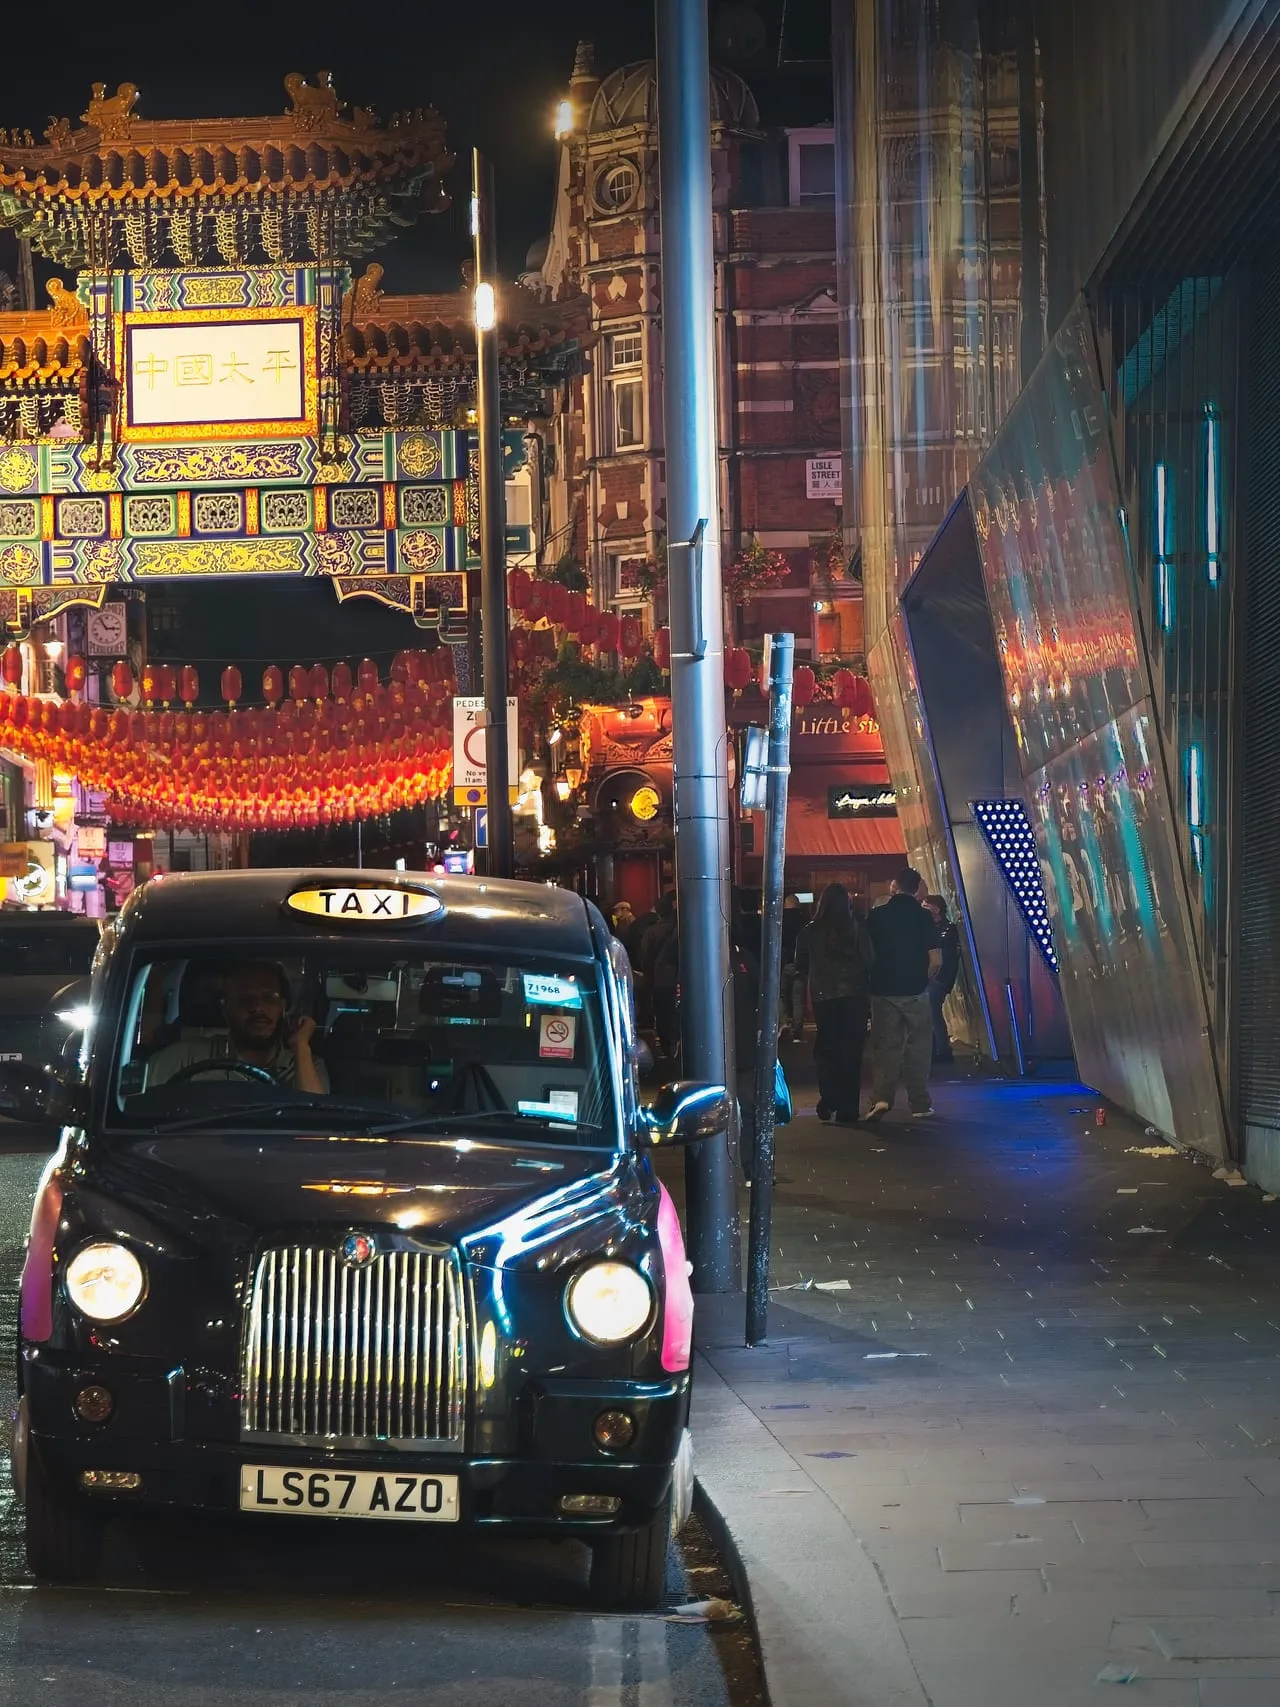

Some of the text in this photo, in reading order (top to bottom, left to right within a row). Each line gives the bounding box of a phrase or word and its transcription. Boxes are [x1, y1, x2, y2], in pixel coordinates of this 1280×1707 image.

[135, 350, 296, 390] 中國太平
[811, 461, 832, 470] LISLE
[811, 470, 840, 479] STREET
[456, 699, 515, 708] PEDESN
[799, 717, 850, 735] Little
[319, 892, 409, 915] TAXI
[528, 983, 561, 994] 71968
[256, 1469, 443, 1514] LS67 AZO
